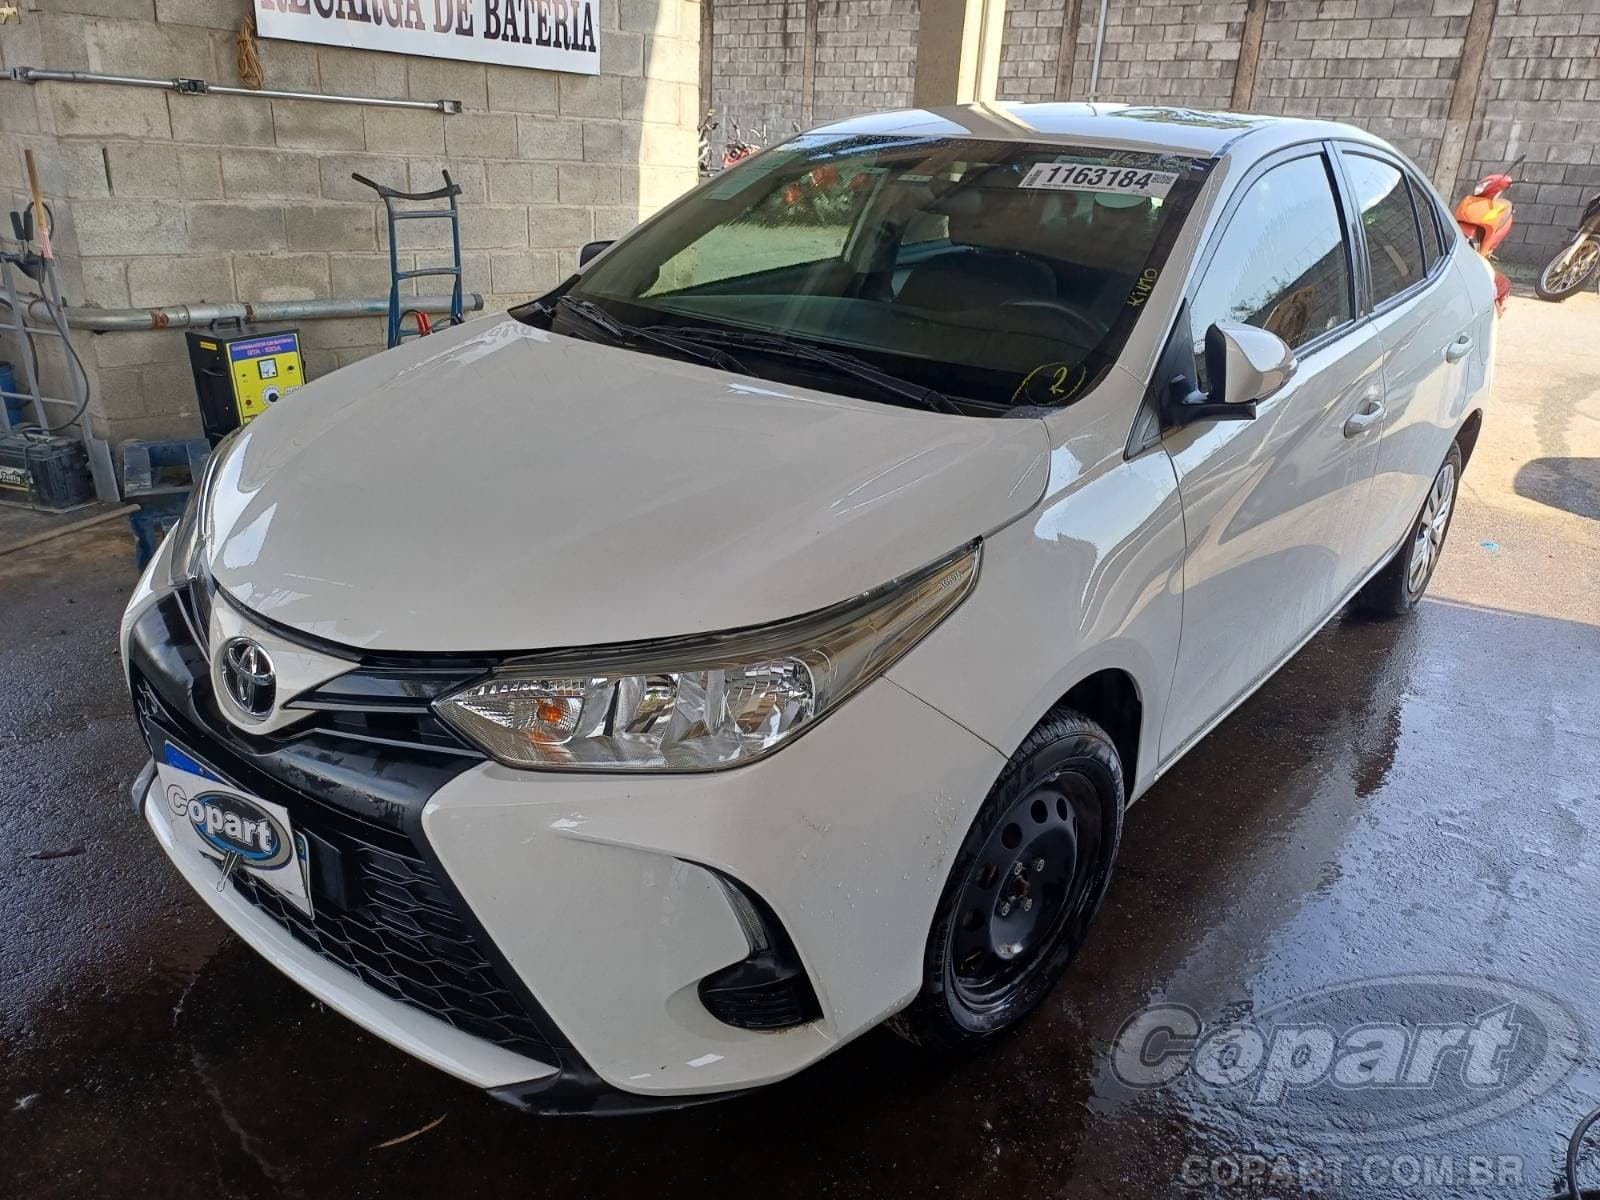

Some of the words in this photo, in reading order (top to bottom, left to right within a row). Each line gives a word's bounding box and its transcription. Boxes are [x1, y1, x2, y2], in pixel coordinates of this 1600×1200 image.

[433, 0, 474, 37] DE
[484, 0, 597, 52] BATERIA
[1047, 165, 1154, 190] 1163184
[166, 783, 273, 855] Copart
